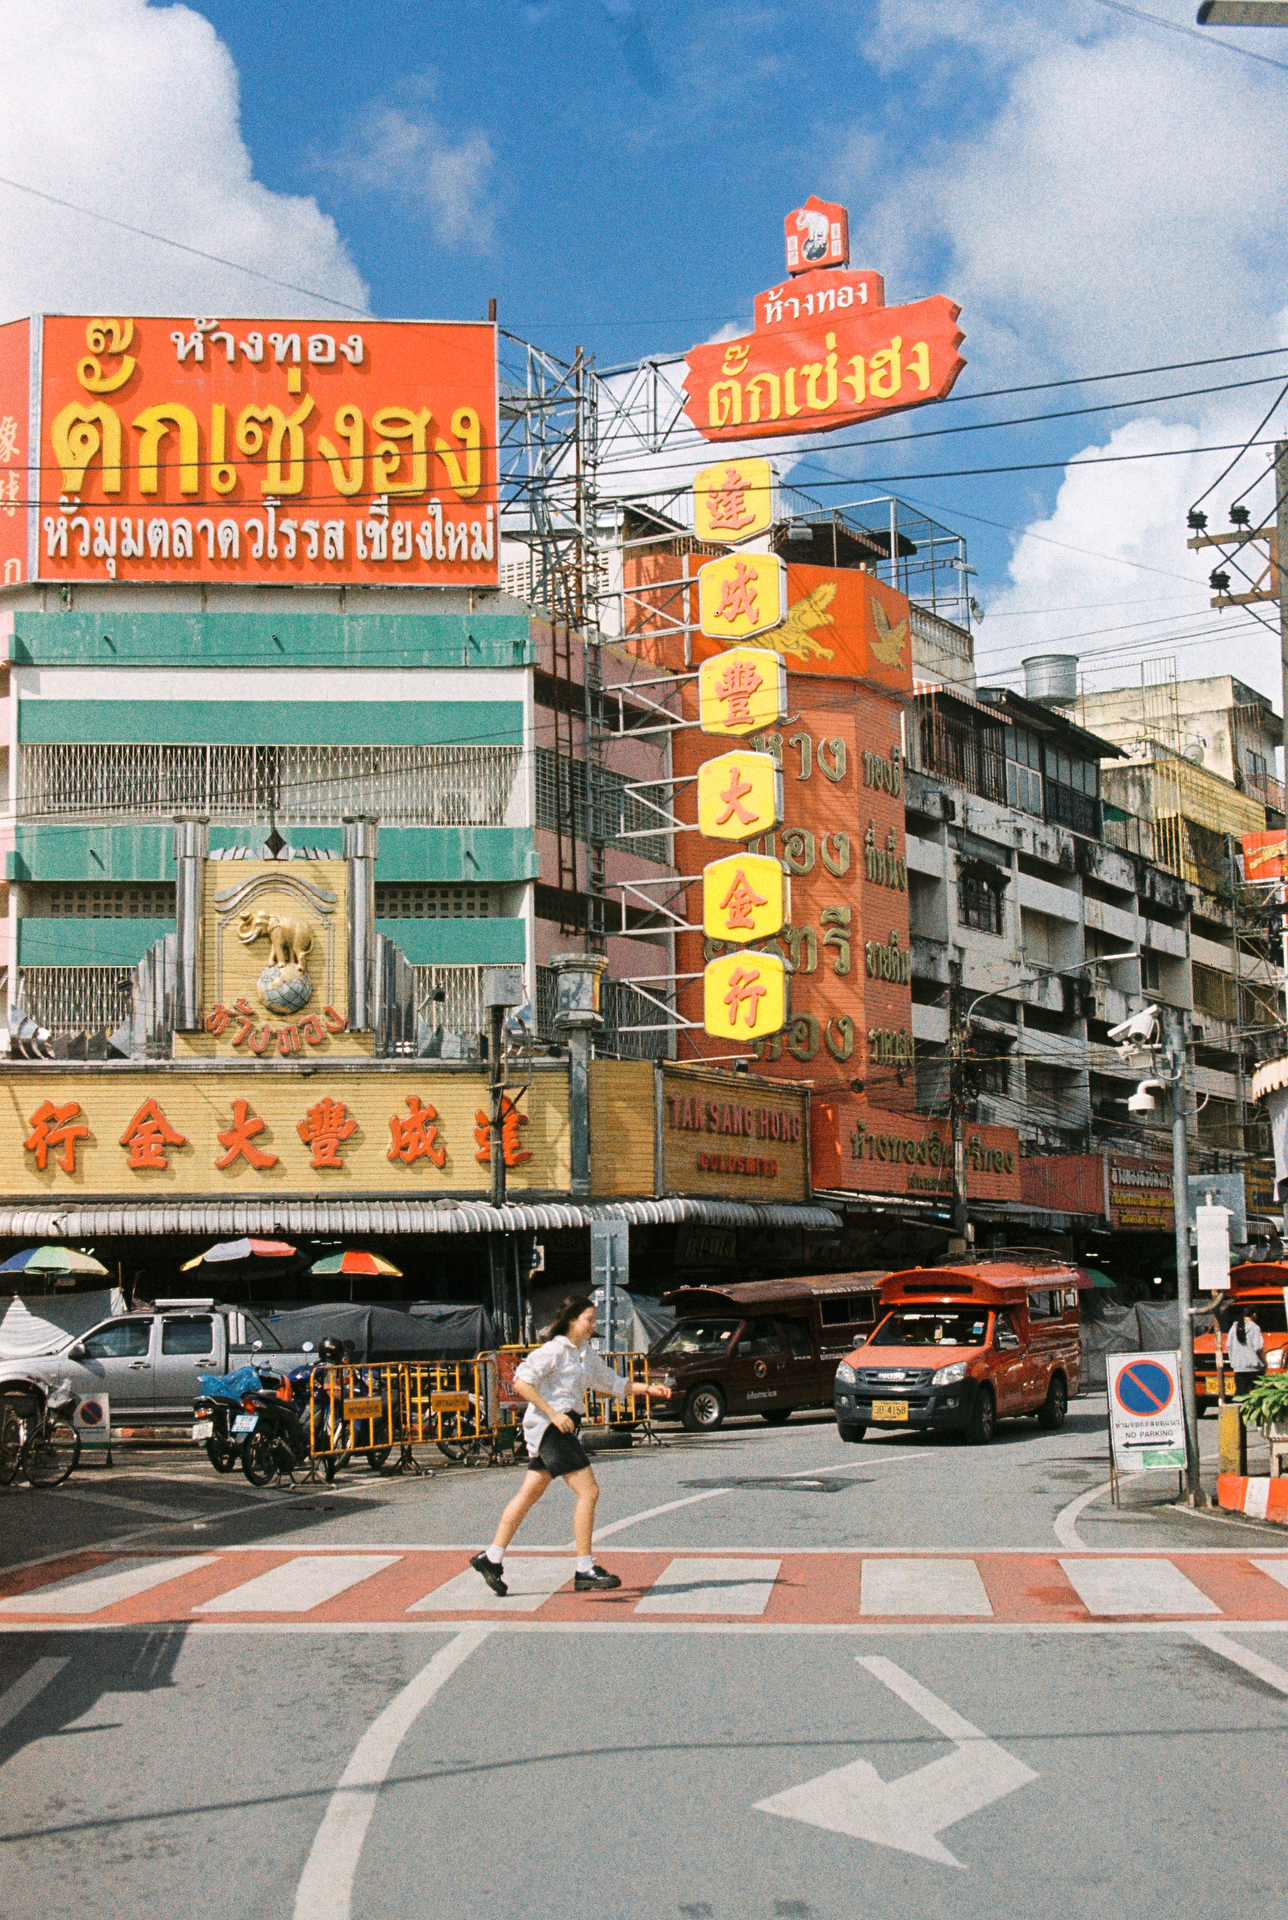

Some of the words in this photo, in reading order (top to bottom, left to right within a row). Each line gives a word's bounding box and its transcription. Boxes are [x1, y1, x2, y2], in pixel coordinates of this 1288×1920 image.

[764, 282, 867, 324] ห้างทอง
[170, 316, 364, 365] ห้างทอง
[708, 332, 930, 430] ตั๊กเซ่งฮง
[50, 318, 481, 498] ตั๊กเซ่งฮง
[206, 998, 346, 1054] ห้างทอง
[708, 1101, 754, 1136] SANG
[759, 1107, 801, 1141] HONG
[699, 1152, 779, 1178] GOLDSMITH
[1126, 1431, 1136, 1439] NO
[1140, 1429, 1174, 1438] PARKING
